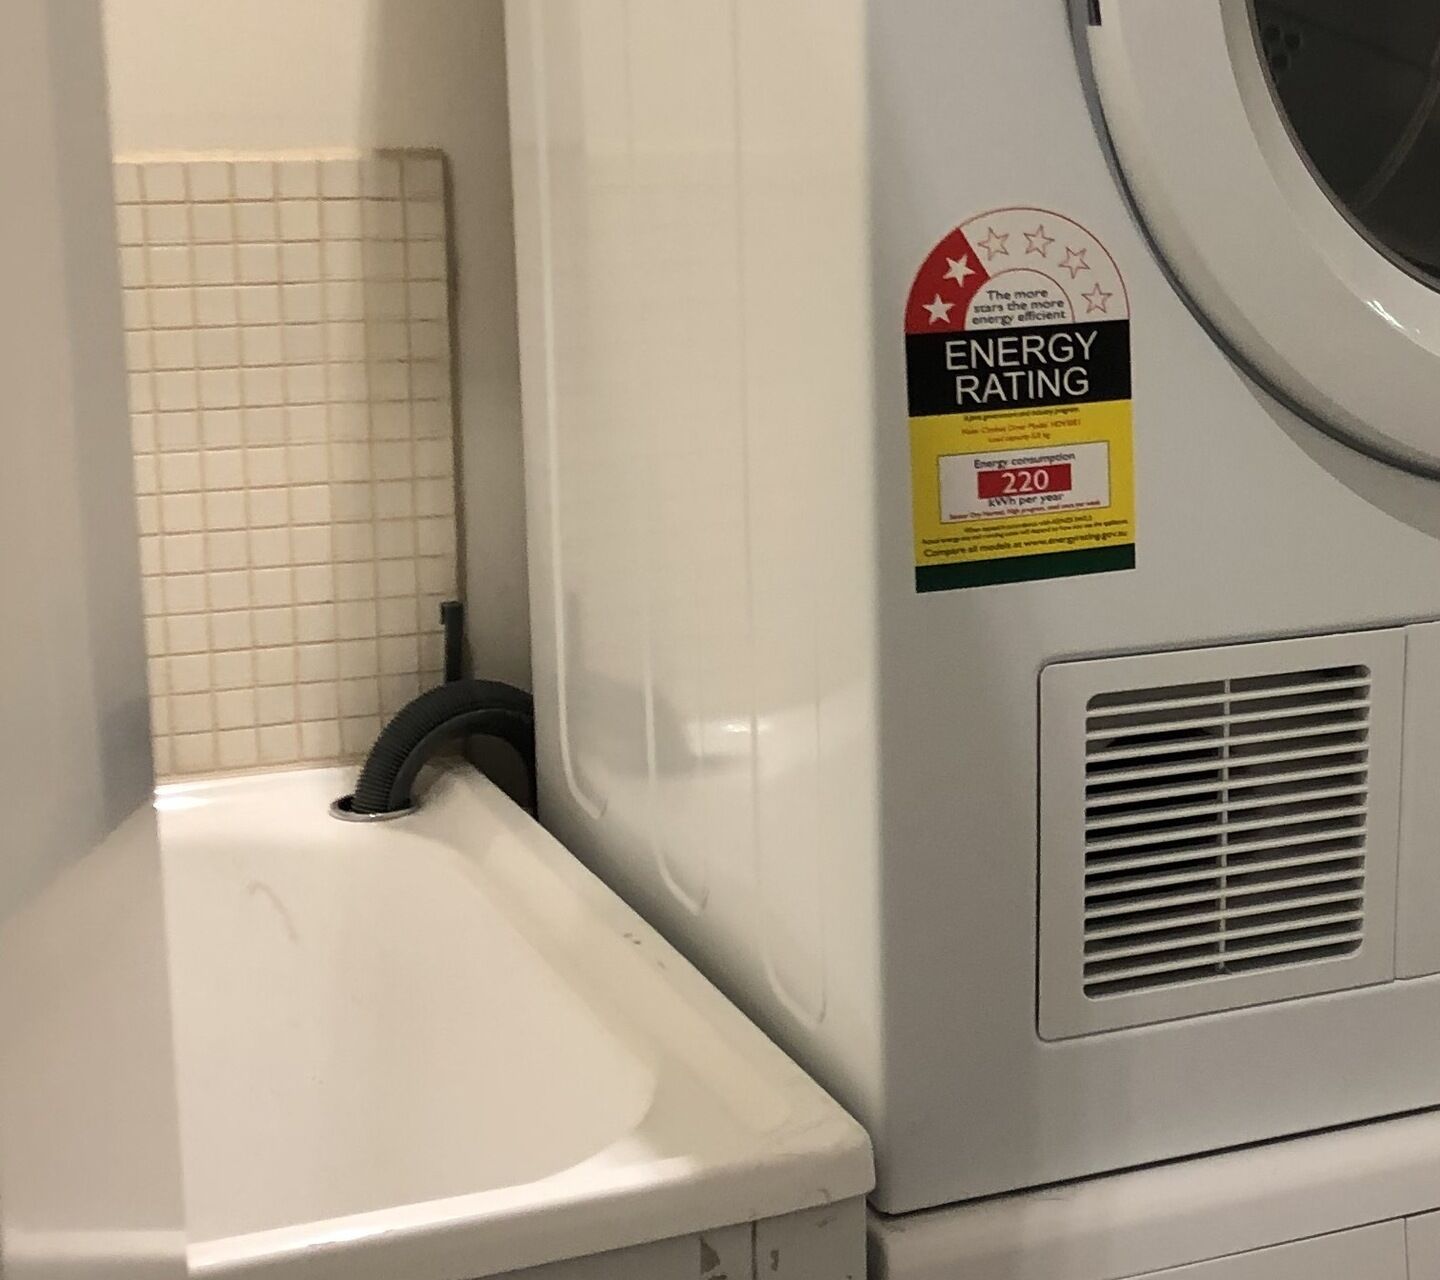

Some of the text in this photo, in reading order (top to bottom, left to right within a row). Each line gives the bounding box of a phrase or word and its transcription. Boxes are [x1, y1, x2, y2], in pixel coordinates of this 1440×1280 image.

[986, 289, 1049, 301] The more
[974, 299, 1065, 314] stars the more
[972, 310, 1066, 326] energy efficient
[945, 330, 1098, 370] ENERGY
[956, 366, 1089, 405] RATING
[974, 453, 1076, 470] Energy consumption
[1001, 469, 1050, 494] 220
[988, 492, 1064, 507] kWh per year
[924, 546, 965, 558] Compare
[968, 545, 978, 553] all
[979, 542, 1010, 552] models
